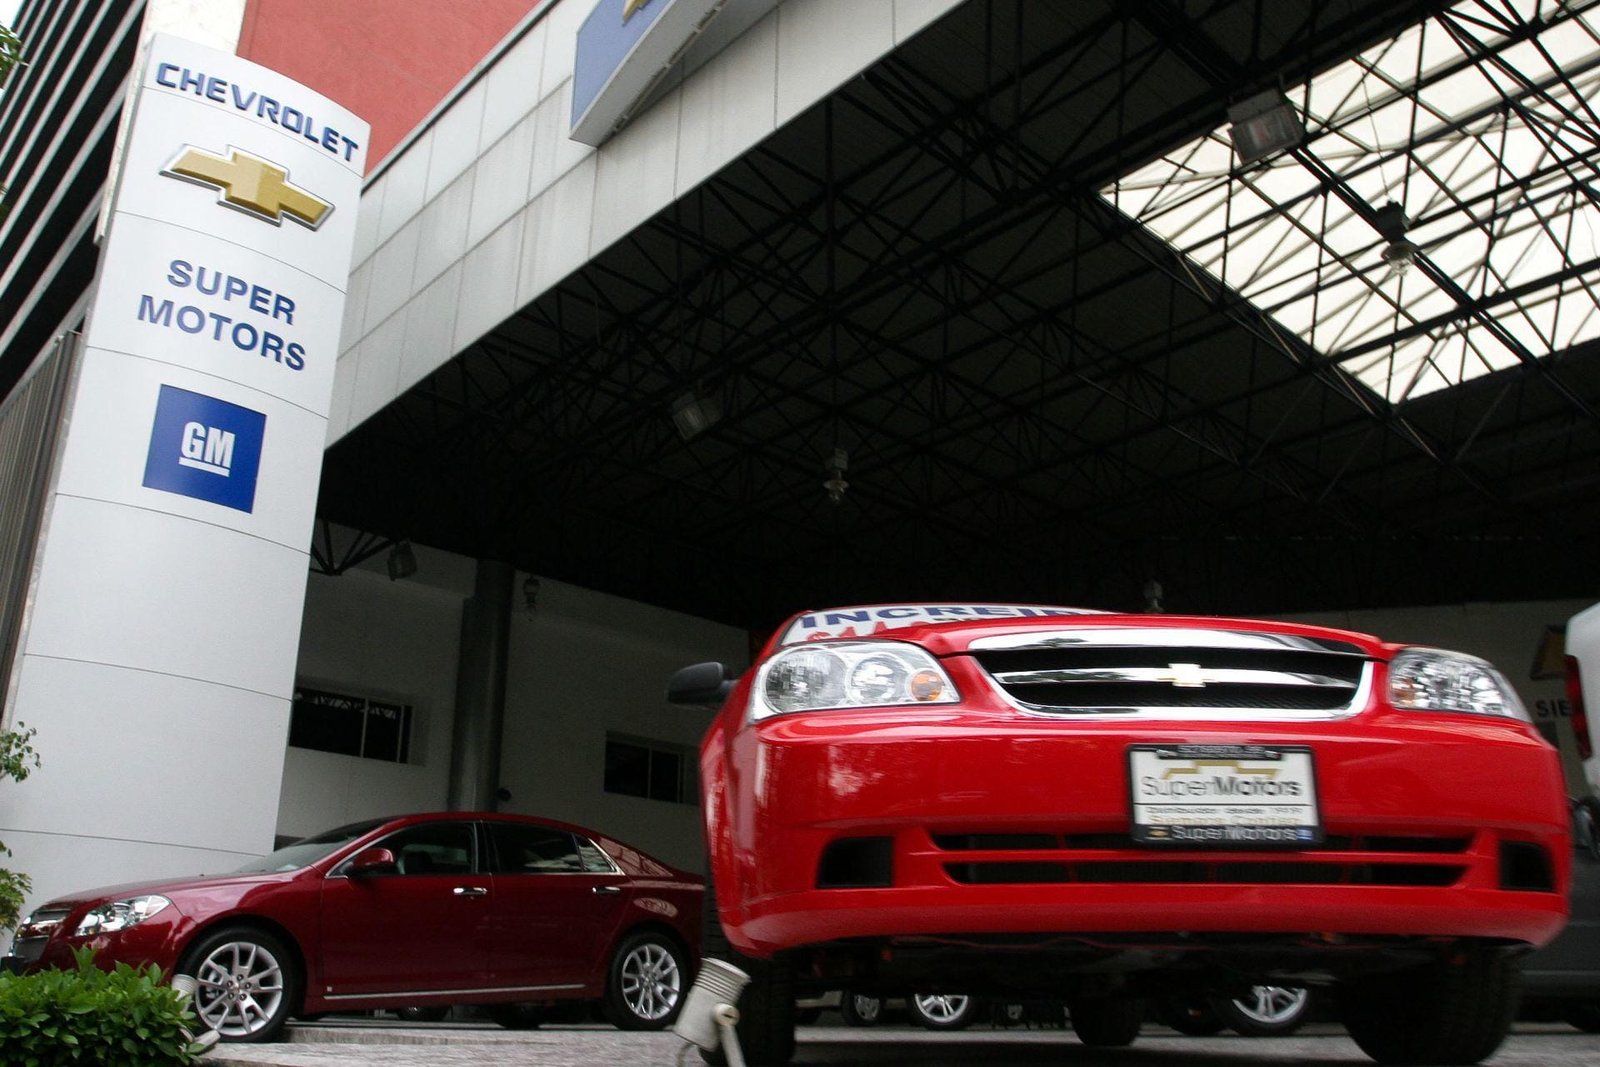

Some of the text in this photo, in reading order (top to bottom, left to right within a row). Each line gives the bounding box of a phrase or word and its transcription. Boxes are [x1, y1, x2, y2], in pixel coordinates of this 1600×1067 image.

[156, 61, 360, 162] CHEVROLET
[167, 259, 296, 325] SUPER
[137, 294, 306, 371] MOTORS
[180, 420, 236, 476] GM
